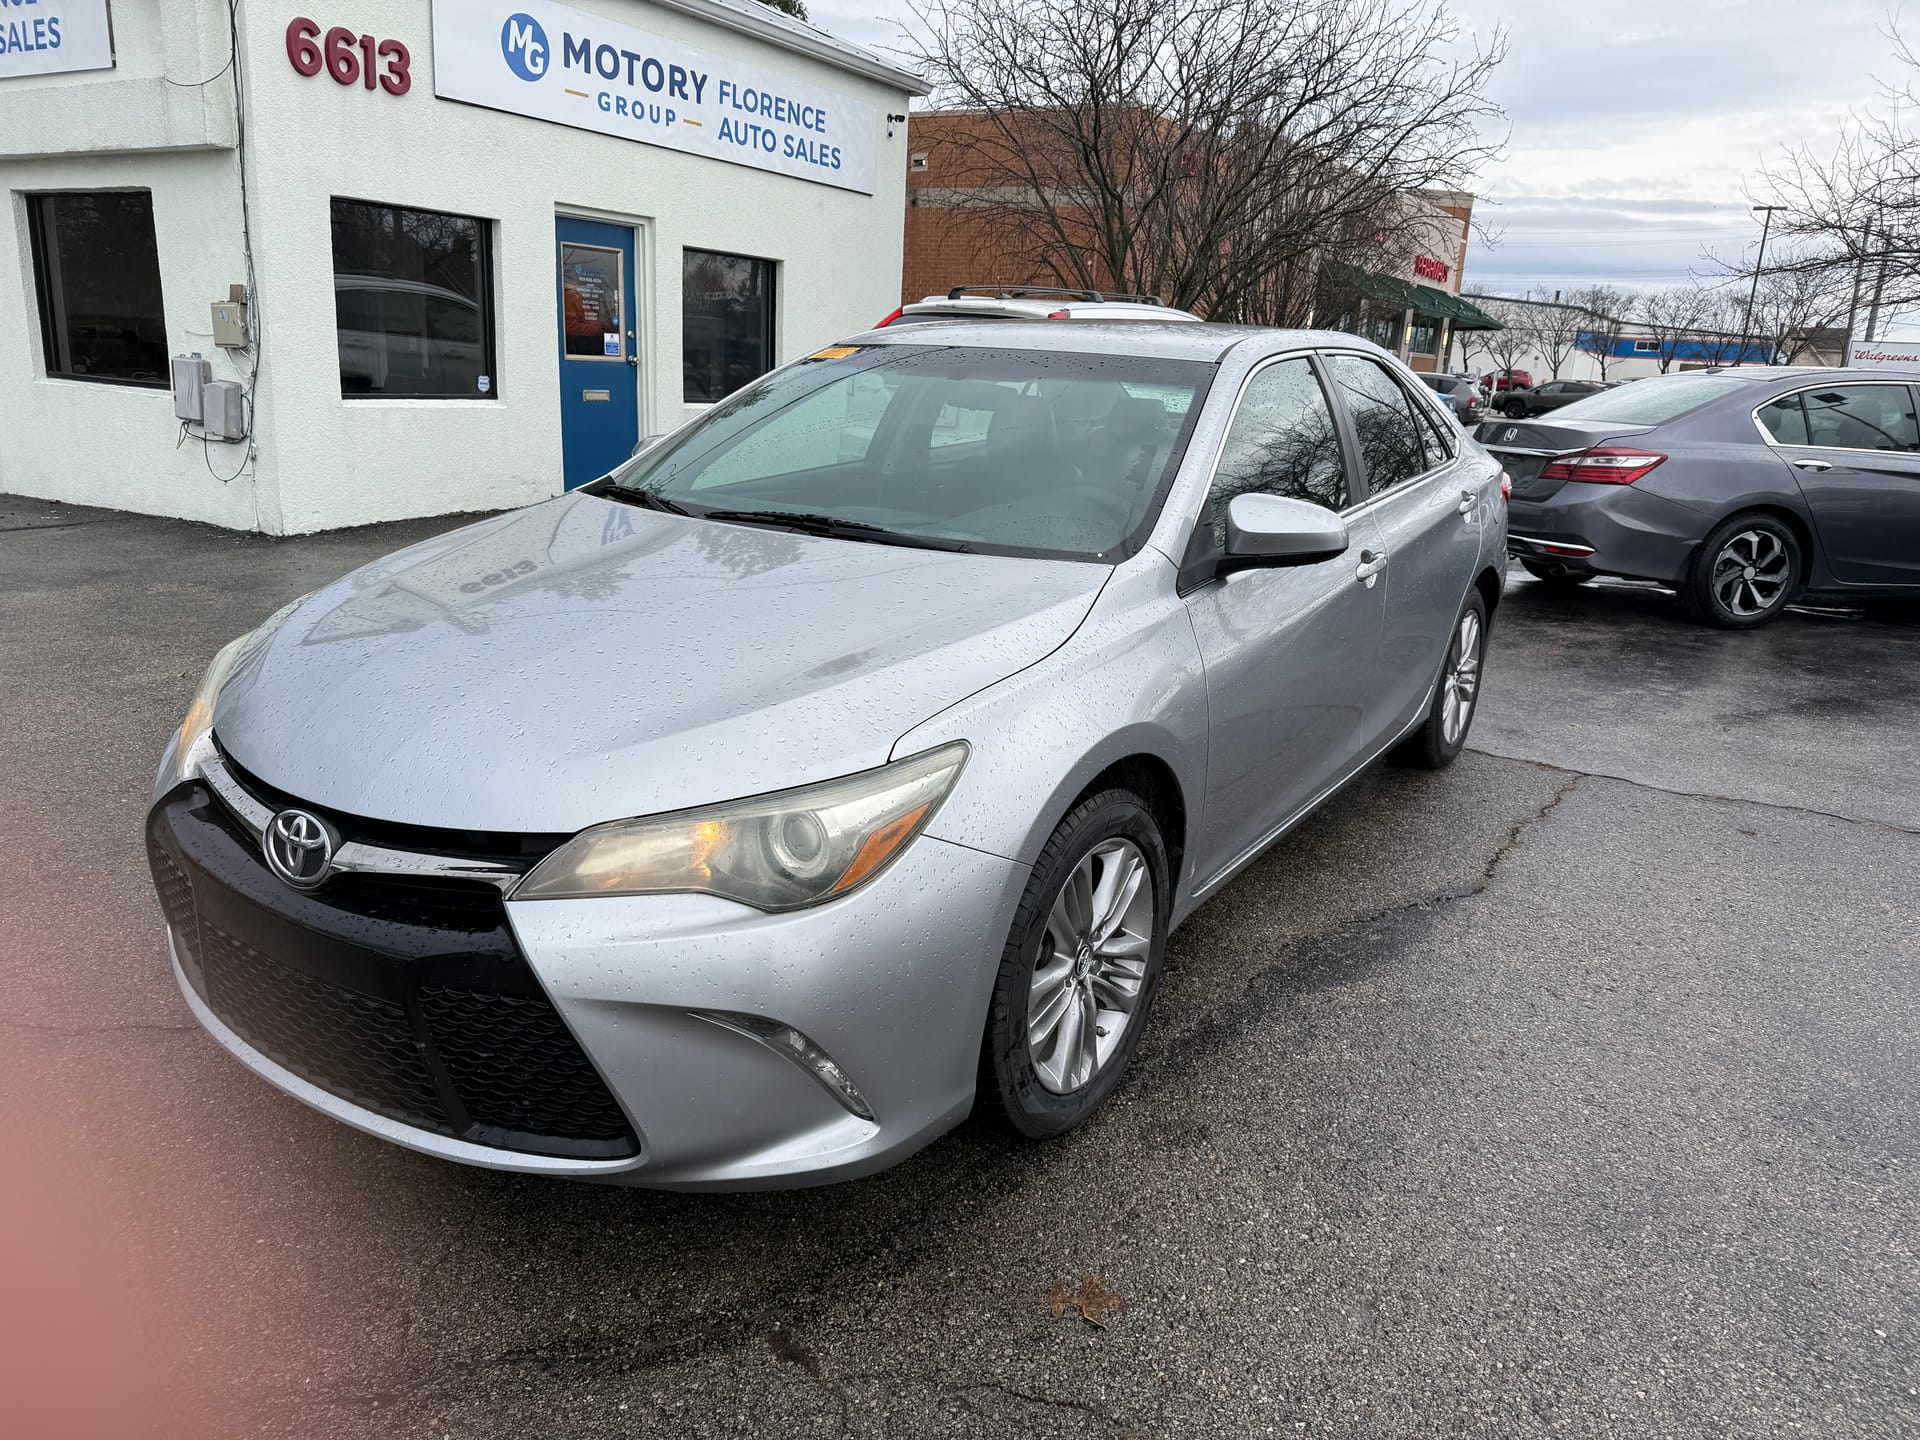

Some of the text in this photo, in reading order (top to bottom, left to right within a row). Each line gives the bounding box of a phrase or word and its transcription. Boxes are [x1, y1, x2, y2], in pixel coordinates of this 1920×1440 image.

[286, 16, 411, 95] 6613
[508, 19, 545, 75] MG
[563, 31, 708, 104] MOTORY
[597, 91, 676, 127] GROUP
[719, 79, 826, 133] FLORENCE
[718, 117, 841, 170] AUTO SALES
[1414, 254, 1449, 283] PHARMACY
[1855, 349, 1919, 363] Walgreens
